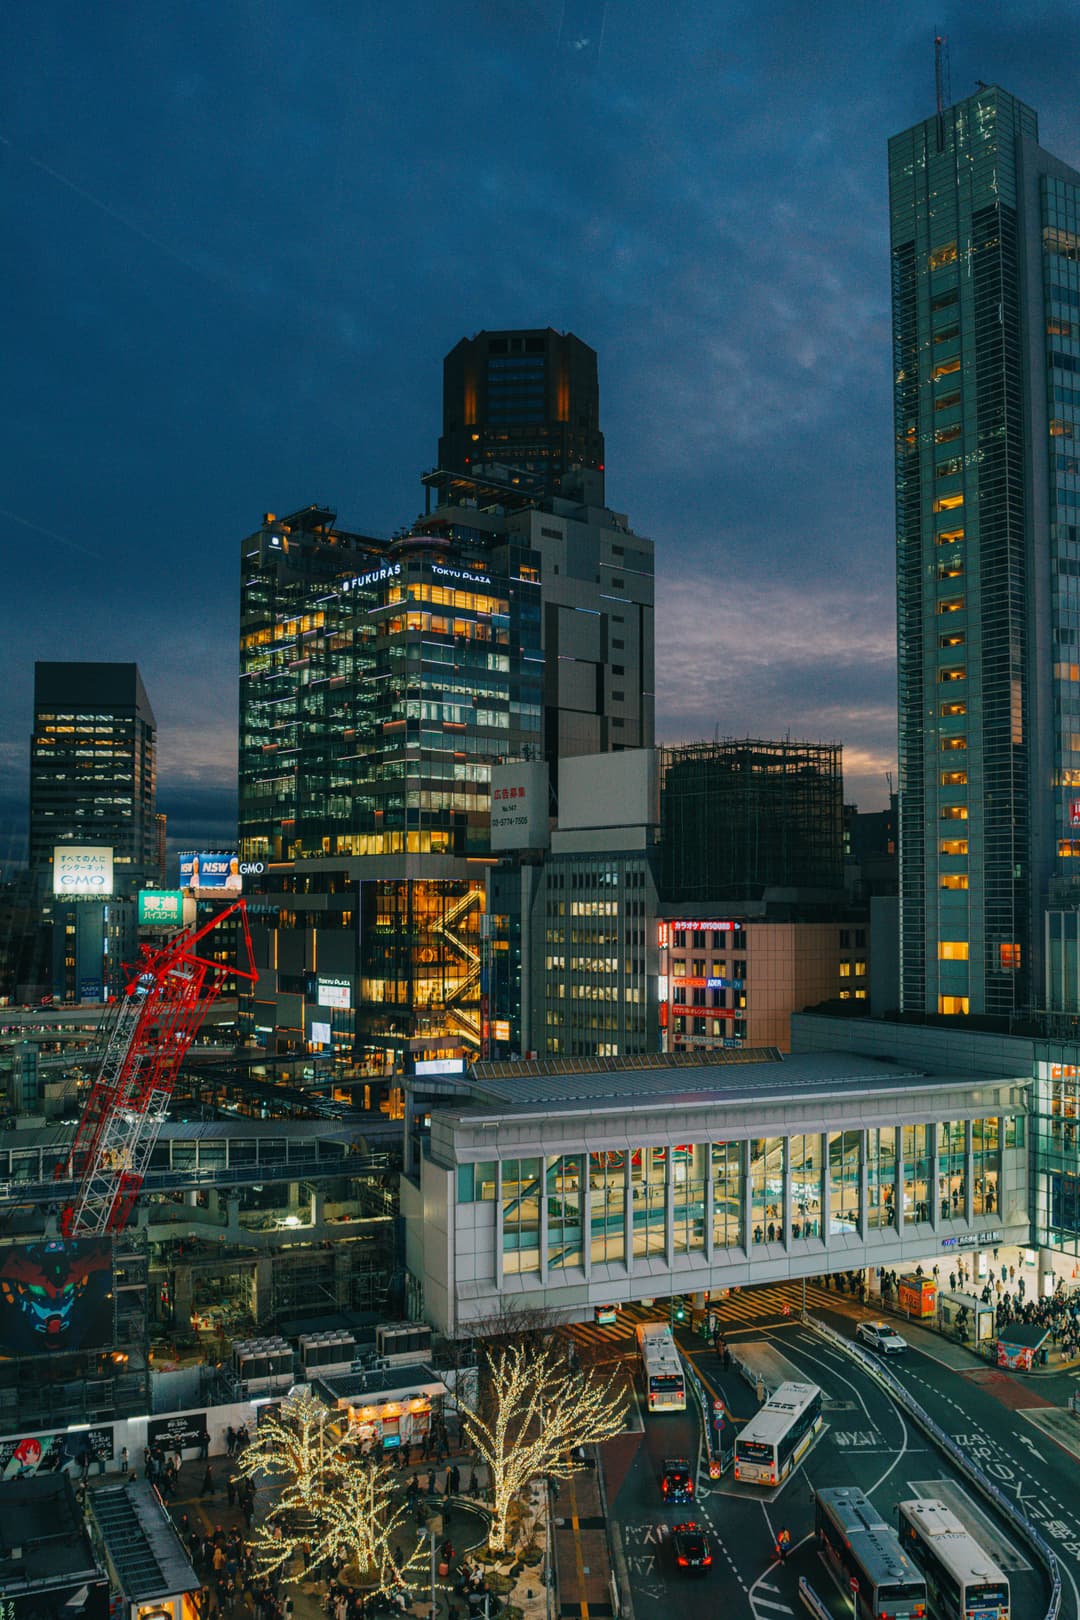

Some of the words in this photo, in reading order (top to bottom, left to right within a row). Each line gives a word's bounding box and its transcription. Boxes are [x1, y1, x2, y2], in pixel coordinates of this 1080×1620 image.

[351, 564, 401, 589] FUKURAS
[431, 565, 461, 578] TOKYU
[462, 572, 491, 585] PLAZA
[60, 864, 105, 872] インターネット
[202, 862, 229, 873] NSW
[239, 862, 264, 874] GMO
[60, 874, 105, 886] GMO
[143, 896, 178, 912] 東進
[143, 911, 178, 920] ハイスクール
